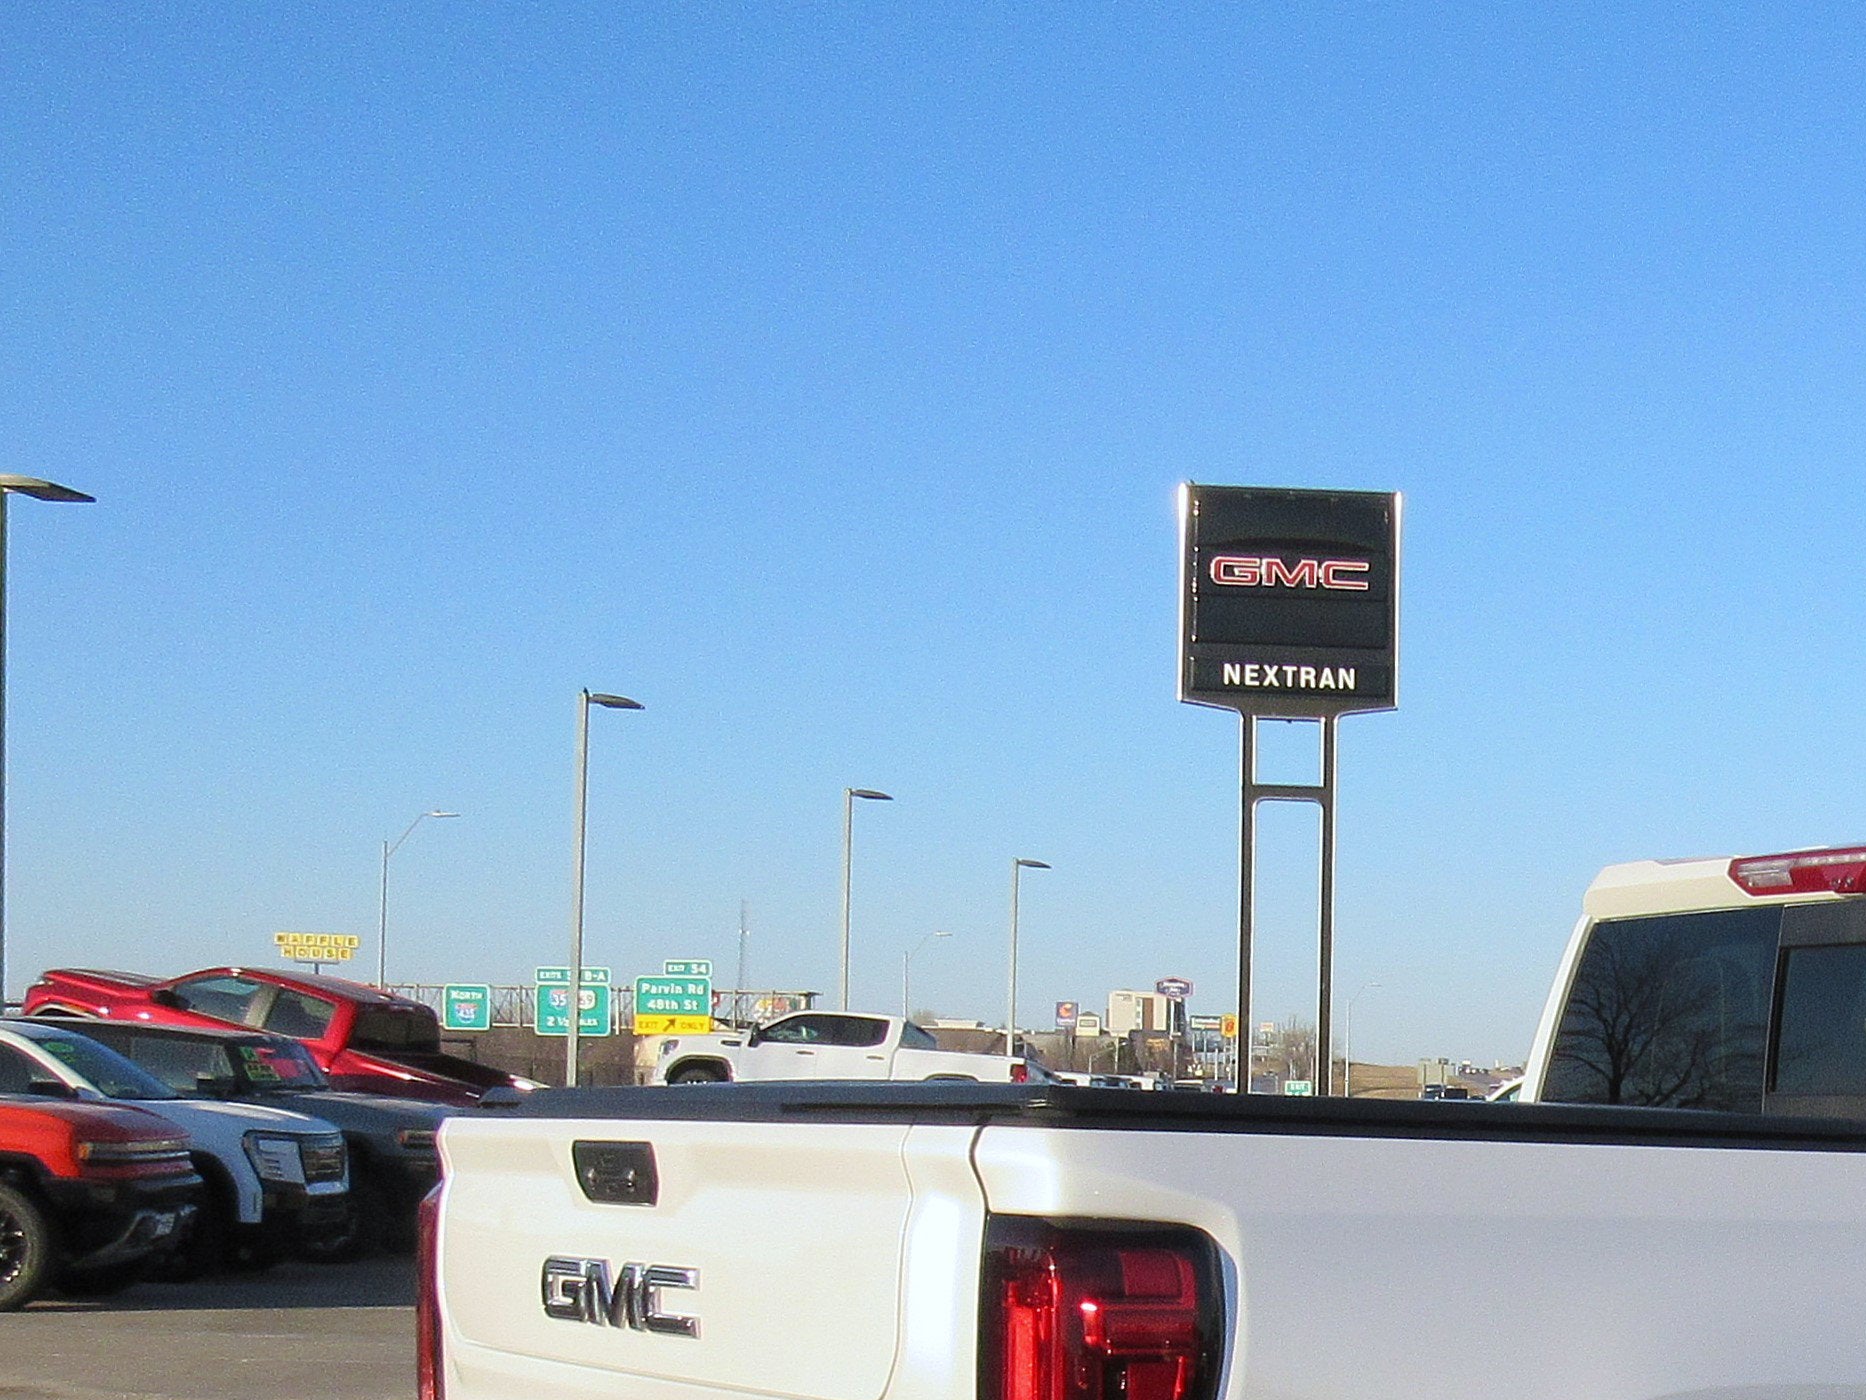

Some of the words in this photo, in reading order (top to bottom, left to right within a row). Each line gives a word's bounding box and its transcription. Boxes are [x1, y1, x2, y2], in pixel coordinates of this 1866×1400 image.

[1210, 556, 1369, 590] GMC
[1222, 662, 1356, 690] NEXTRAN
[276, 932, 357, 947] WAFFLE
[283, 948, 349, 959] HOUSE
[641, 982, 683, 994] Parvin
[687, 983, 705, 995] Rd
[647, 998, 679, 1010] 48th
[683, 998, 698, 1011] St
[541, 1255, 702, 1339] GMC
